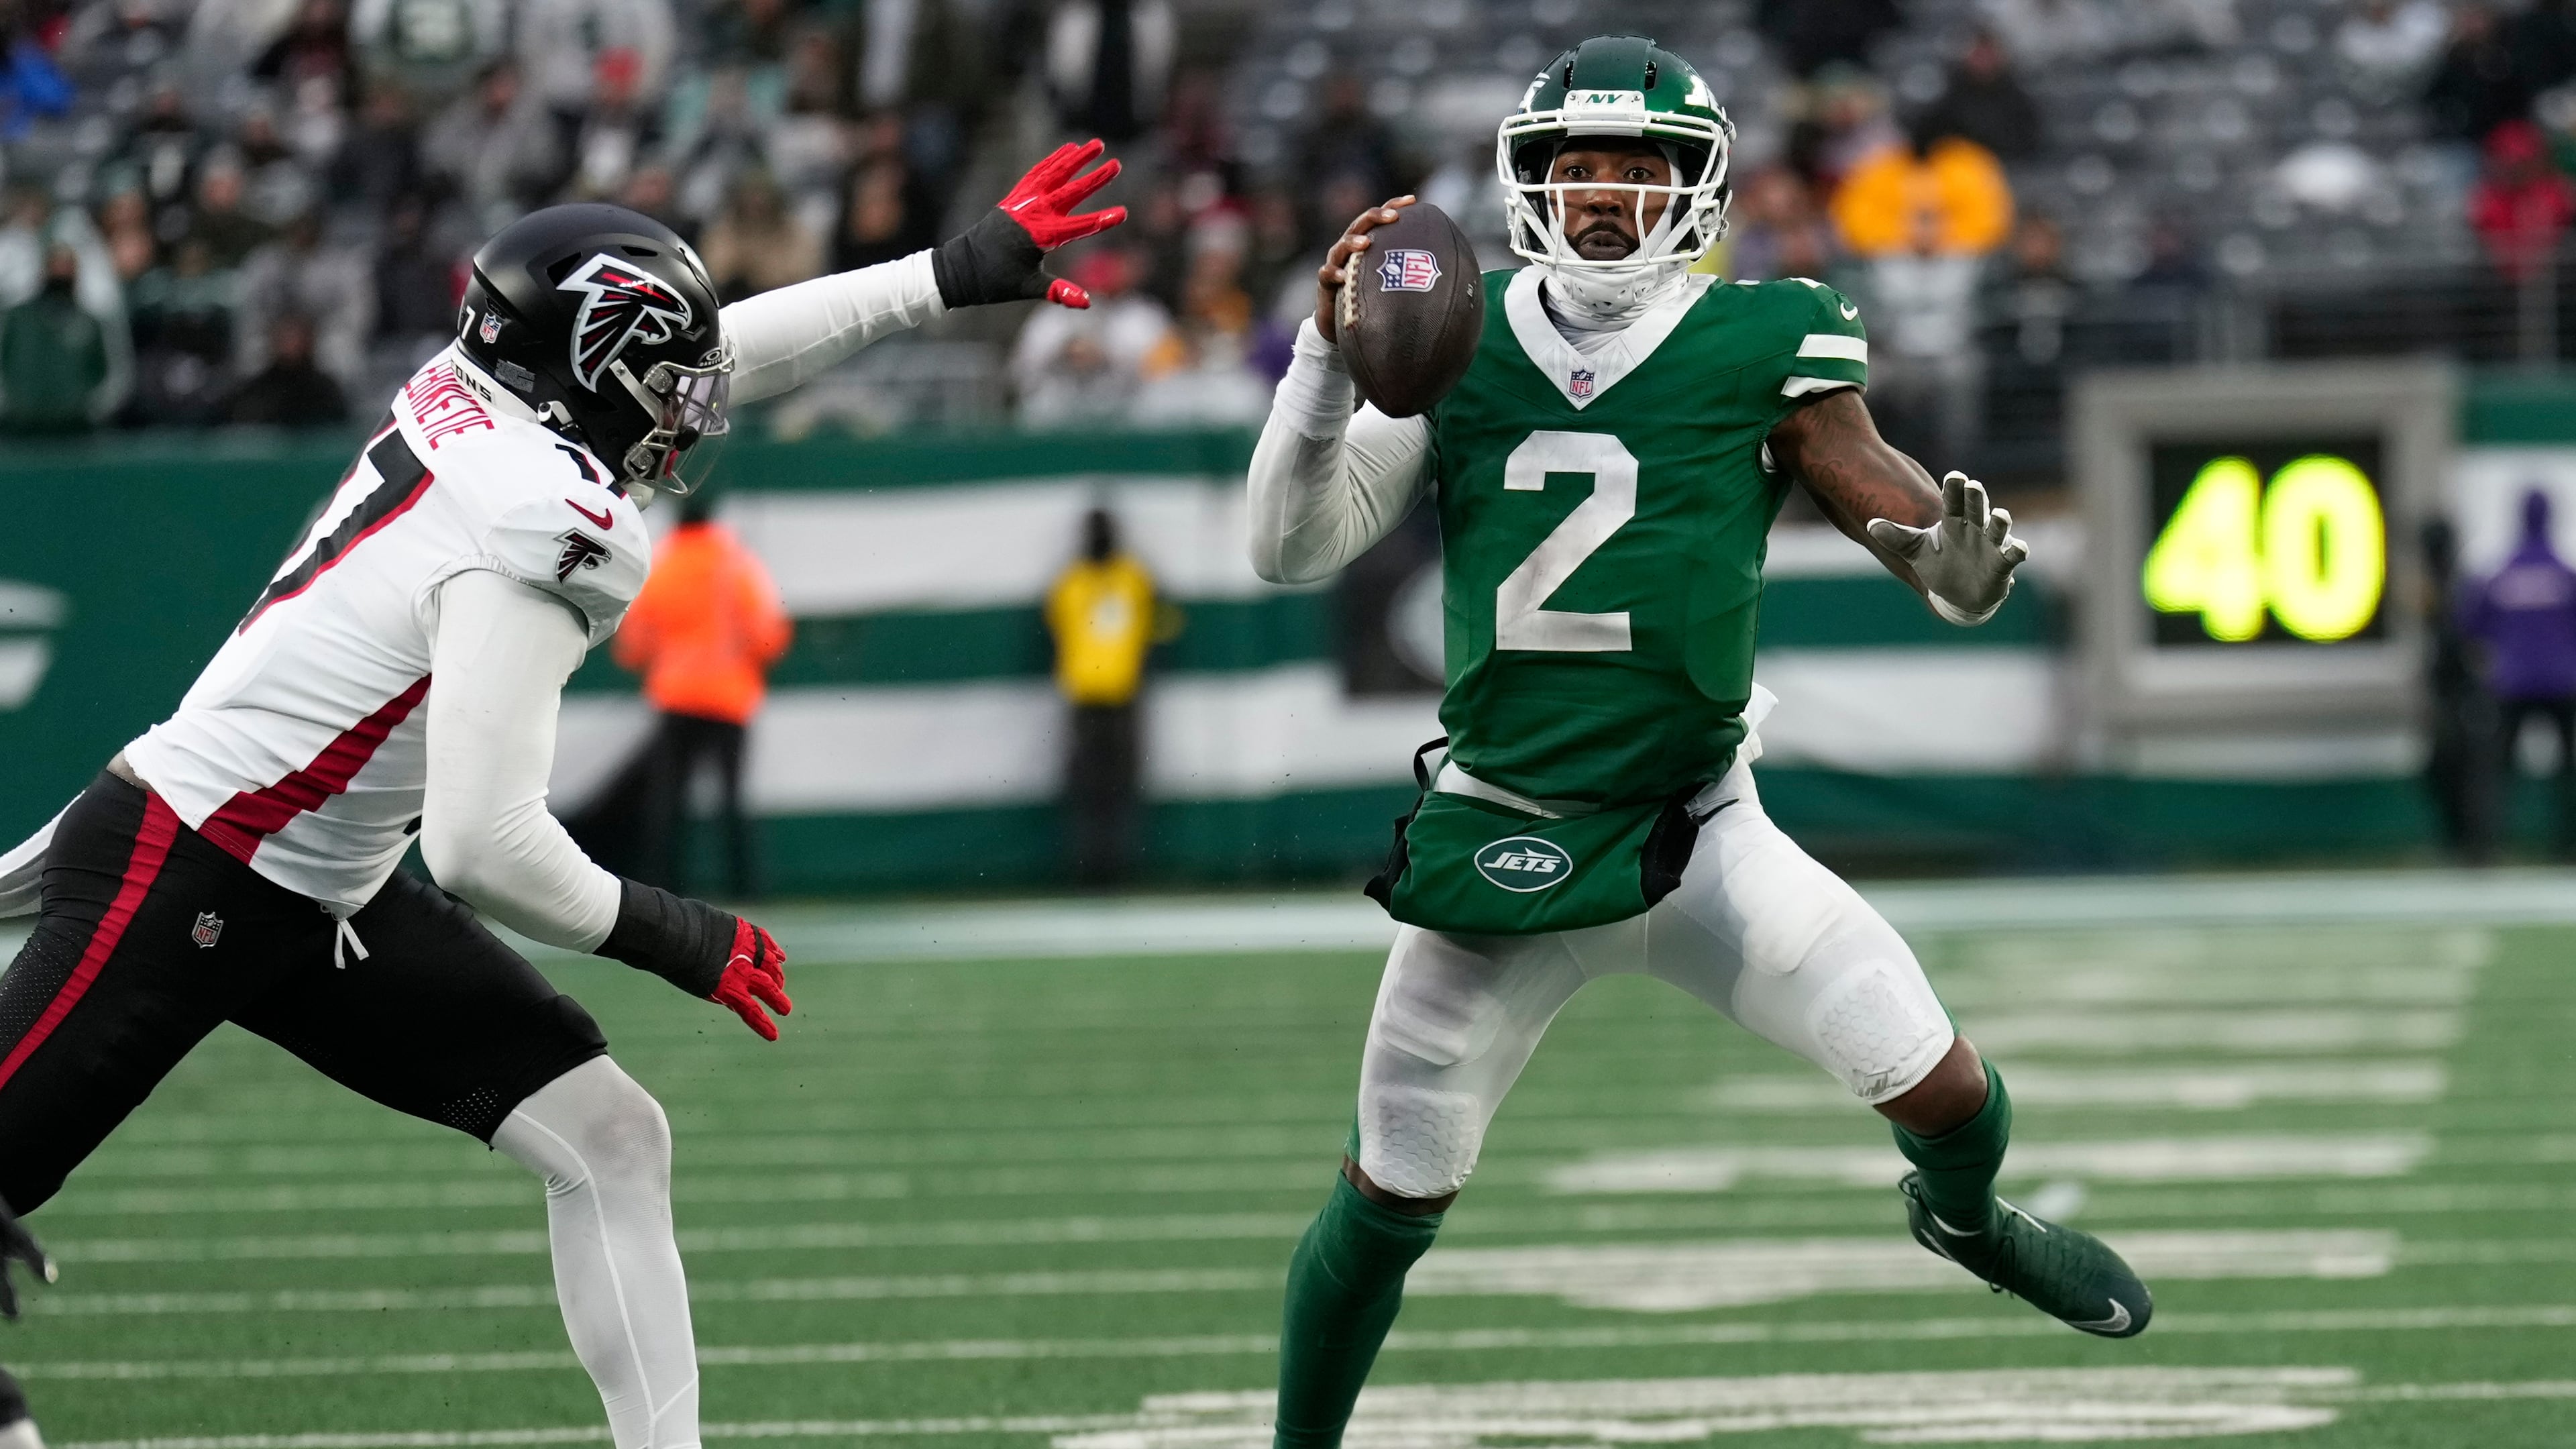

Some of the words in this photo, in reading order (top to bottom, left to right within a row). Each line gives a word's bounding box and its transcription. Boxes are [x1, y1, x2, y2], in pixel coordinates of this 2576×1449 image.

[1585, 93, 1623, 104] NY
[1405, 255, 1432, 286] NFL
[1572, 380, 1591, 394] NFL
[1495, 429, 1640, 652] 2
[2143, 453, 2386, 643] 40
[1483, 847, 1562, 873] JETS
[197, 926, 215, 943] NFL
